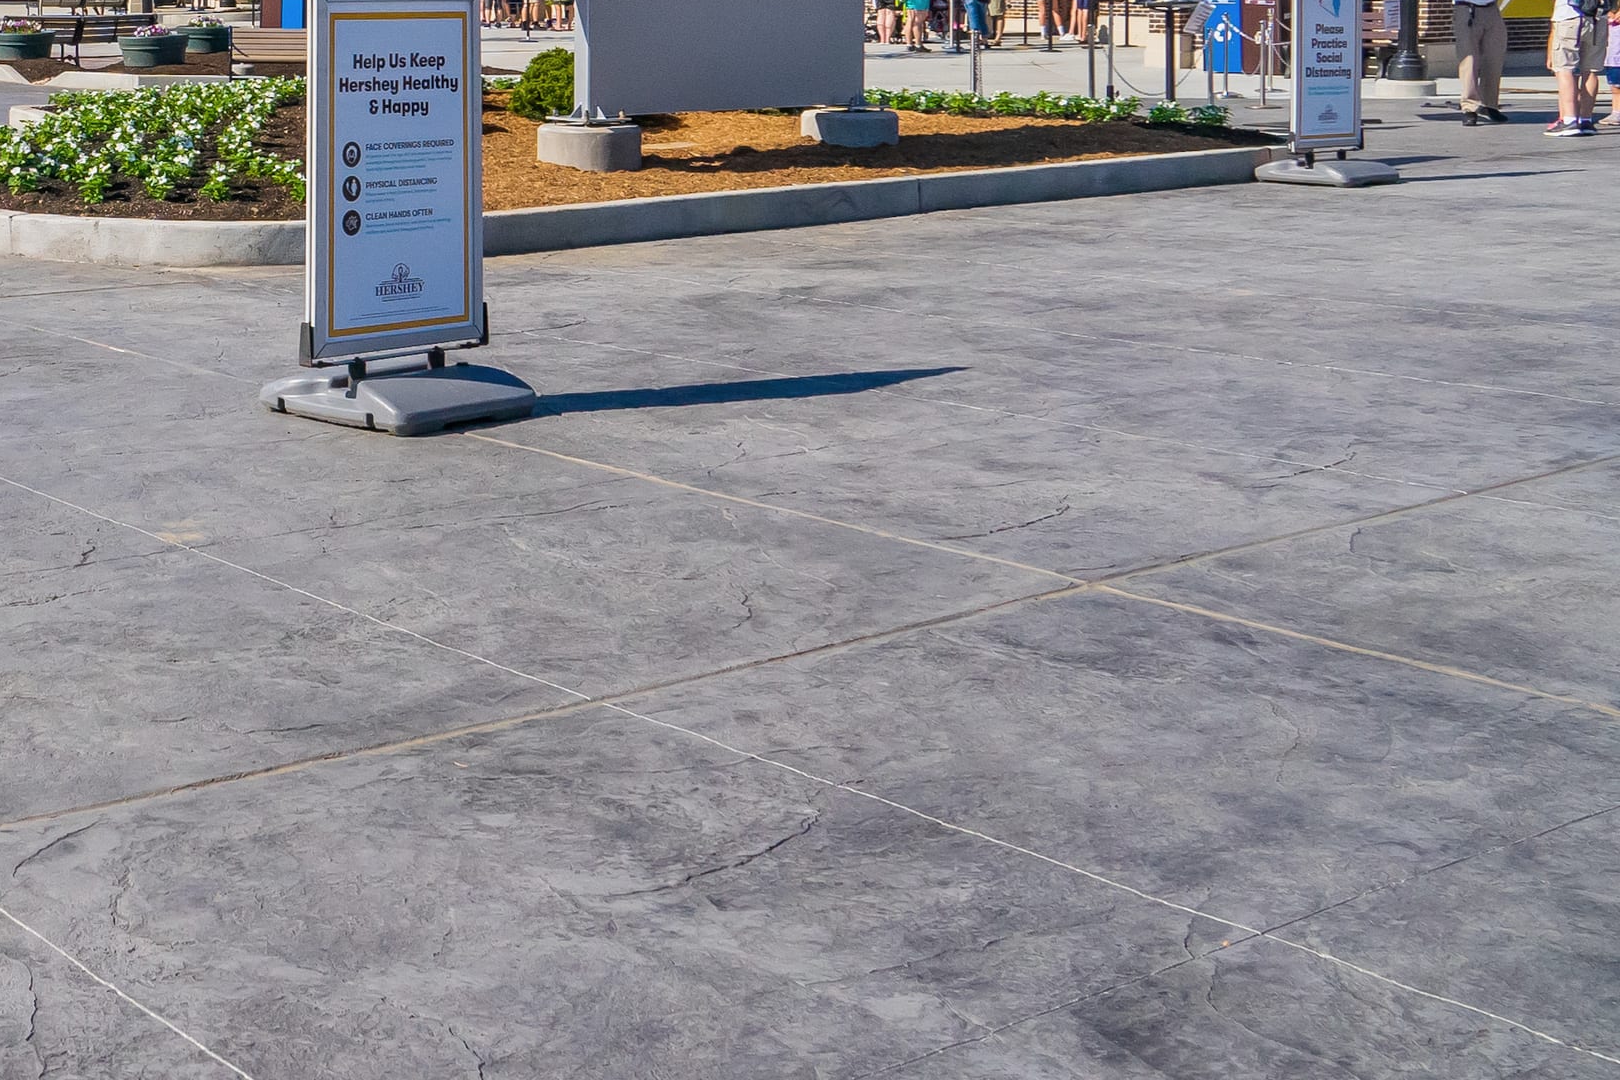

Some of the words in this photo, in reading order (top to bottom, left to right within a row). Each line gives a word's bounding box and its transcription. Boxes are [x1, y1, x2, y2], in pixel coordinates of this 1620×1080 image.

[1315, 24, 1344, 35] Please
[1311, 38, 1348, 49] Practice
[353, 53, 385, 73] Help
[390, 52, 407, 69] Us
[410, 51, 445, 70] Keep
[1316, 52, 1343, 63] Social
[1305, 66, 1352, 79] Distancing
[339, 77, 399, 96] Hershey
[402, 75, 459, 93] Healthy
[369, 100, 379, 115] &
[382, 99, 429, 117] Happy
[365, 143, 381, 151] FACE
[383, 141, 421, 150] COVERINGS
[423, 139, 454, 147] REQUIRED
[365, 180, 396, 189] PHYSICAL
[398, 177, 438, 187] DISTANCING
[365, 212, 387, 220] CLEAN
[388, 210, 410, 218] HANDS
[411, 208, 433, 217] OFTEN
[375, 282, 425, 296] HERSHEY
